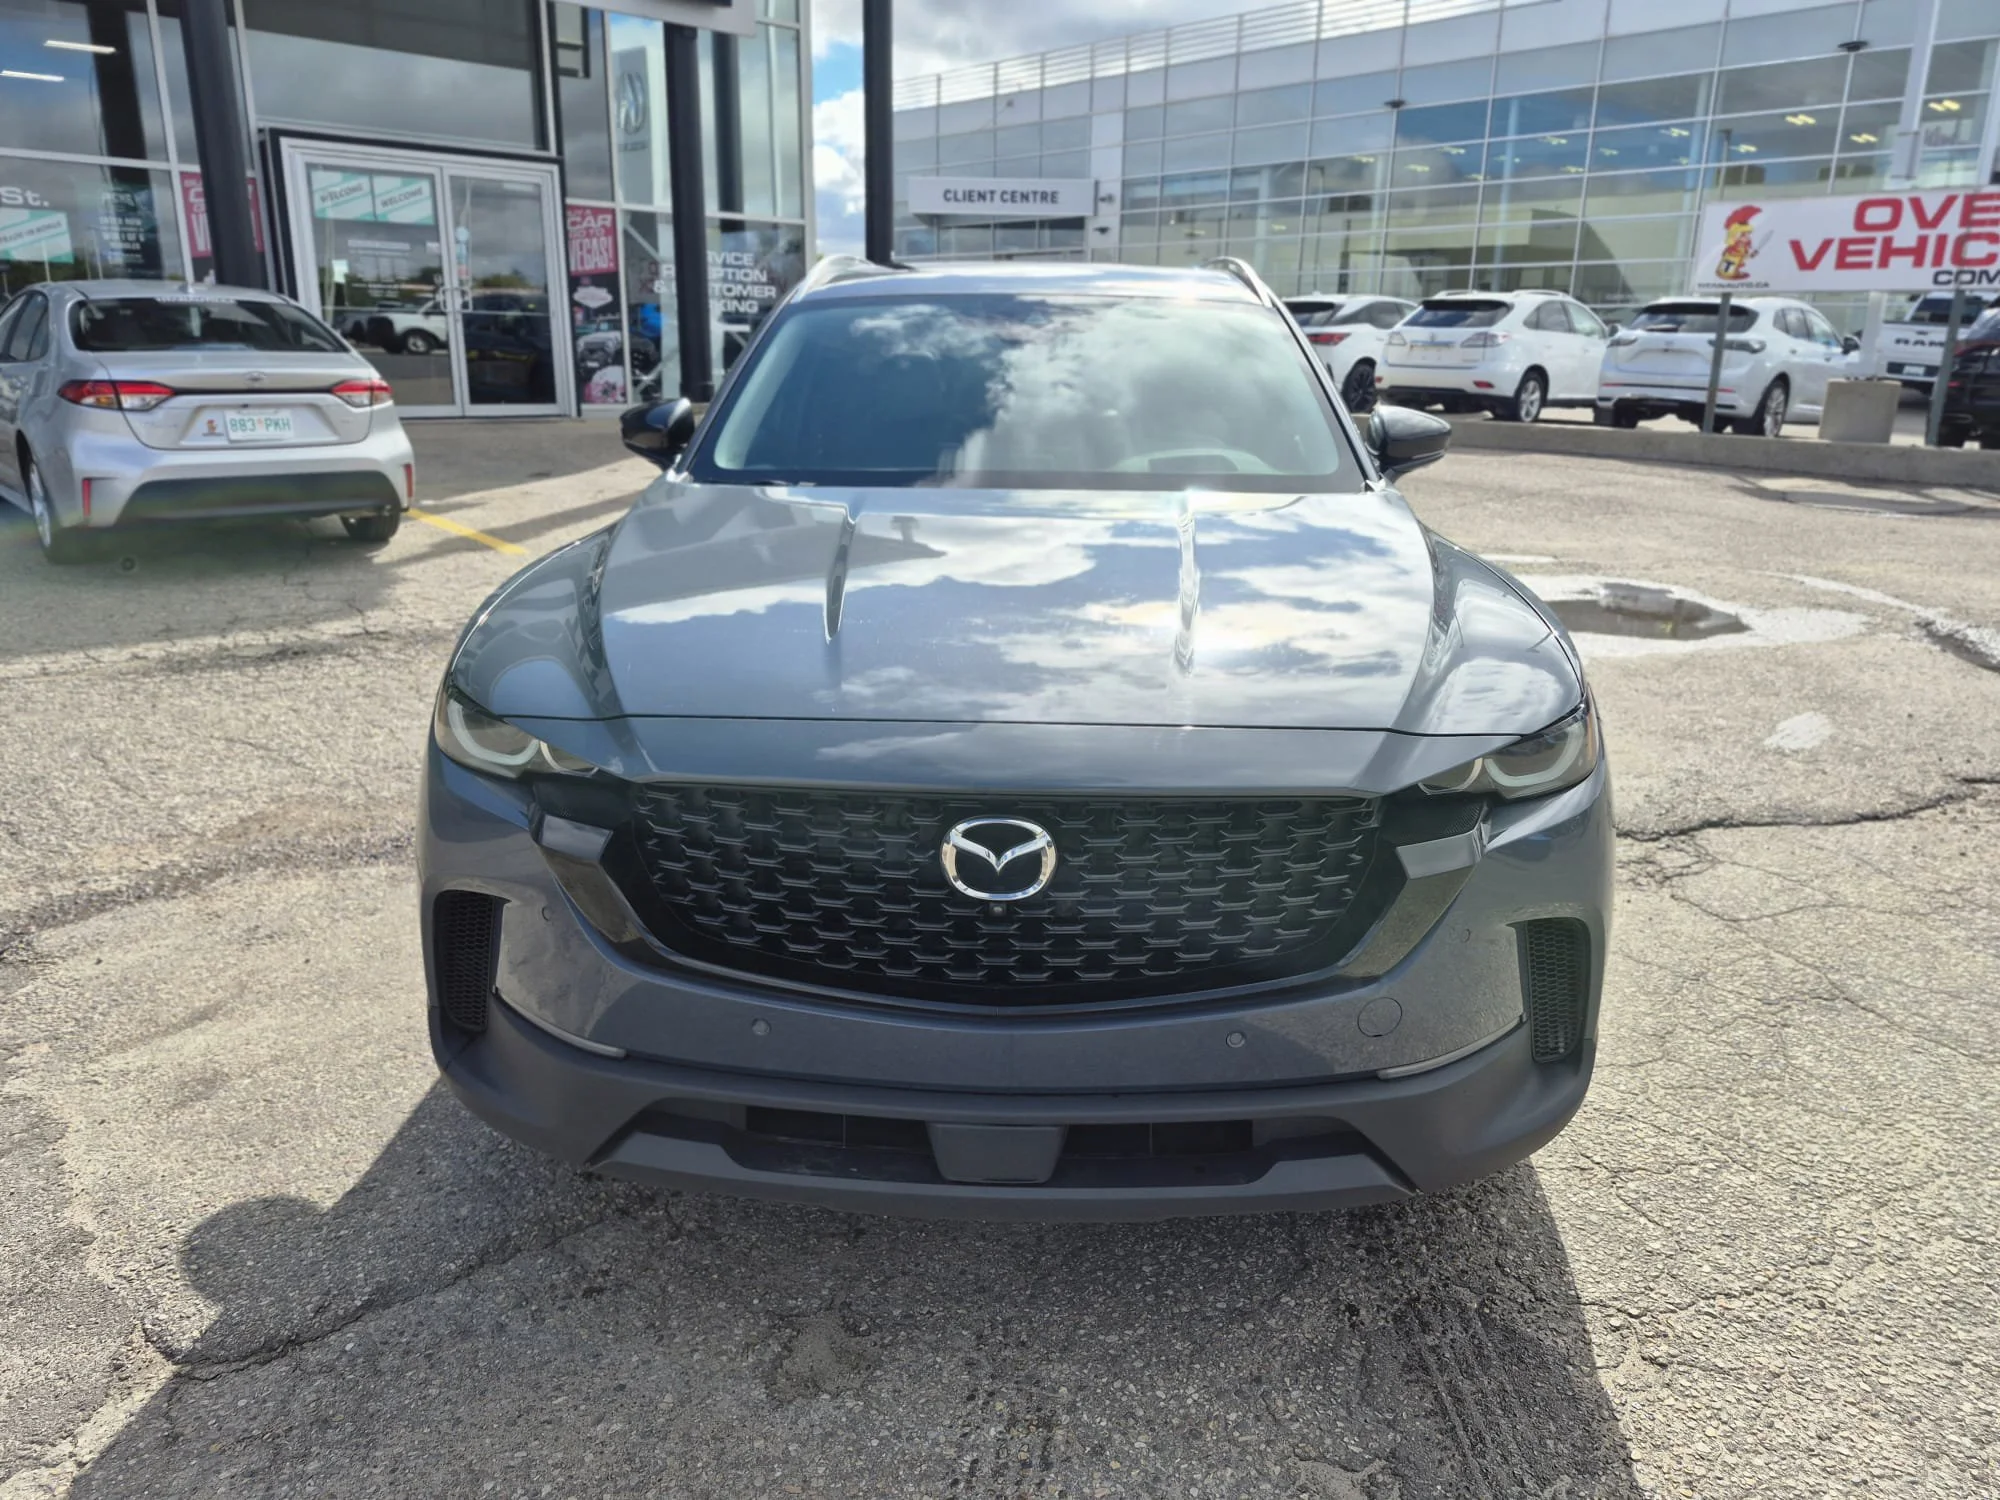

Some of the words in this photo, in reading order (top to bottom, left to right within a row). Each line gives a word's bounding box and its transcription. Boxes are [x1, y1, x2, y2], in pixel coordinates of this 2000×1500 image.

[0, 186, 50, 208] St.
[320, 183, 364, 203] WELCOME
[380, 186, 424, 208] WELCOME
[943, 188, 996, 203] CLIENT
[1000, 189, 1059, 204] CENTRE
[568, 214, 613, 230] CAR
[567, 235, 615, 273] VEGAS!
[708, 251, 754, 266] VICE
[1789, 232, 2000, 272] VEHIC
[654, 280, 665, 293] &
[710, 299, 758, 314] KING
[1894, 338, 1945, 347] RAM
[229, 418, 257, 432] 883
[264, 418, 291, 432] PKH
